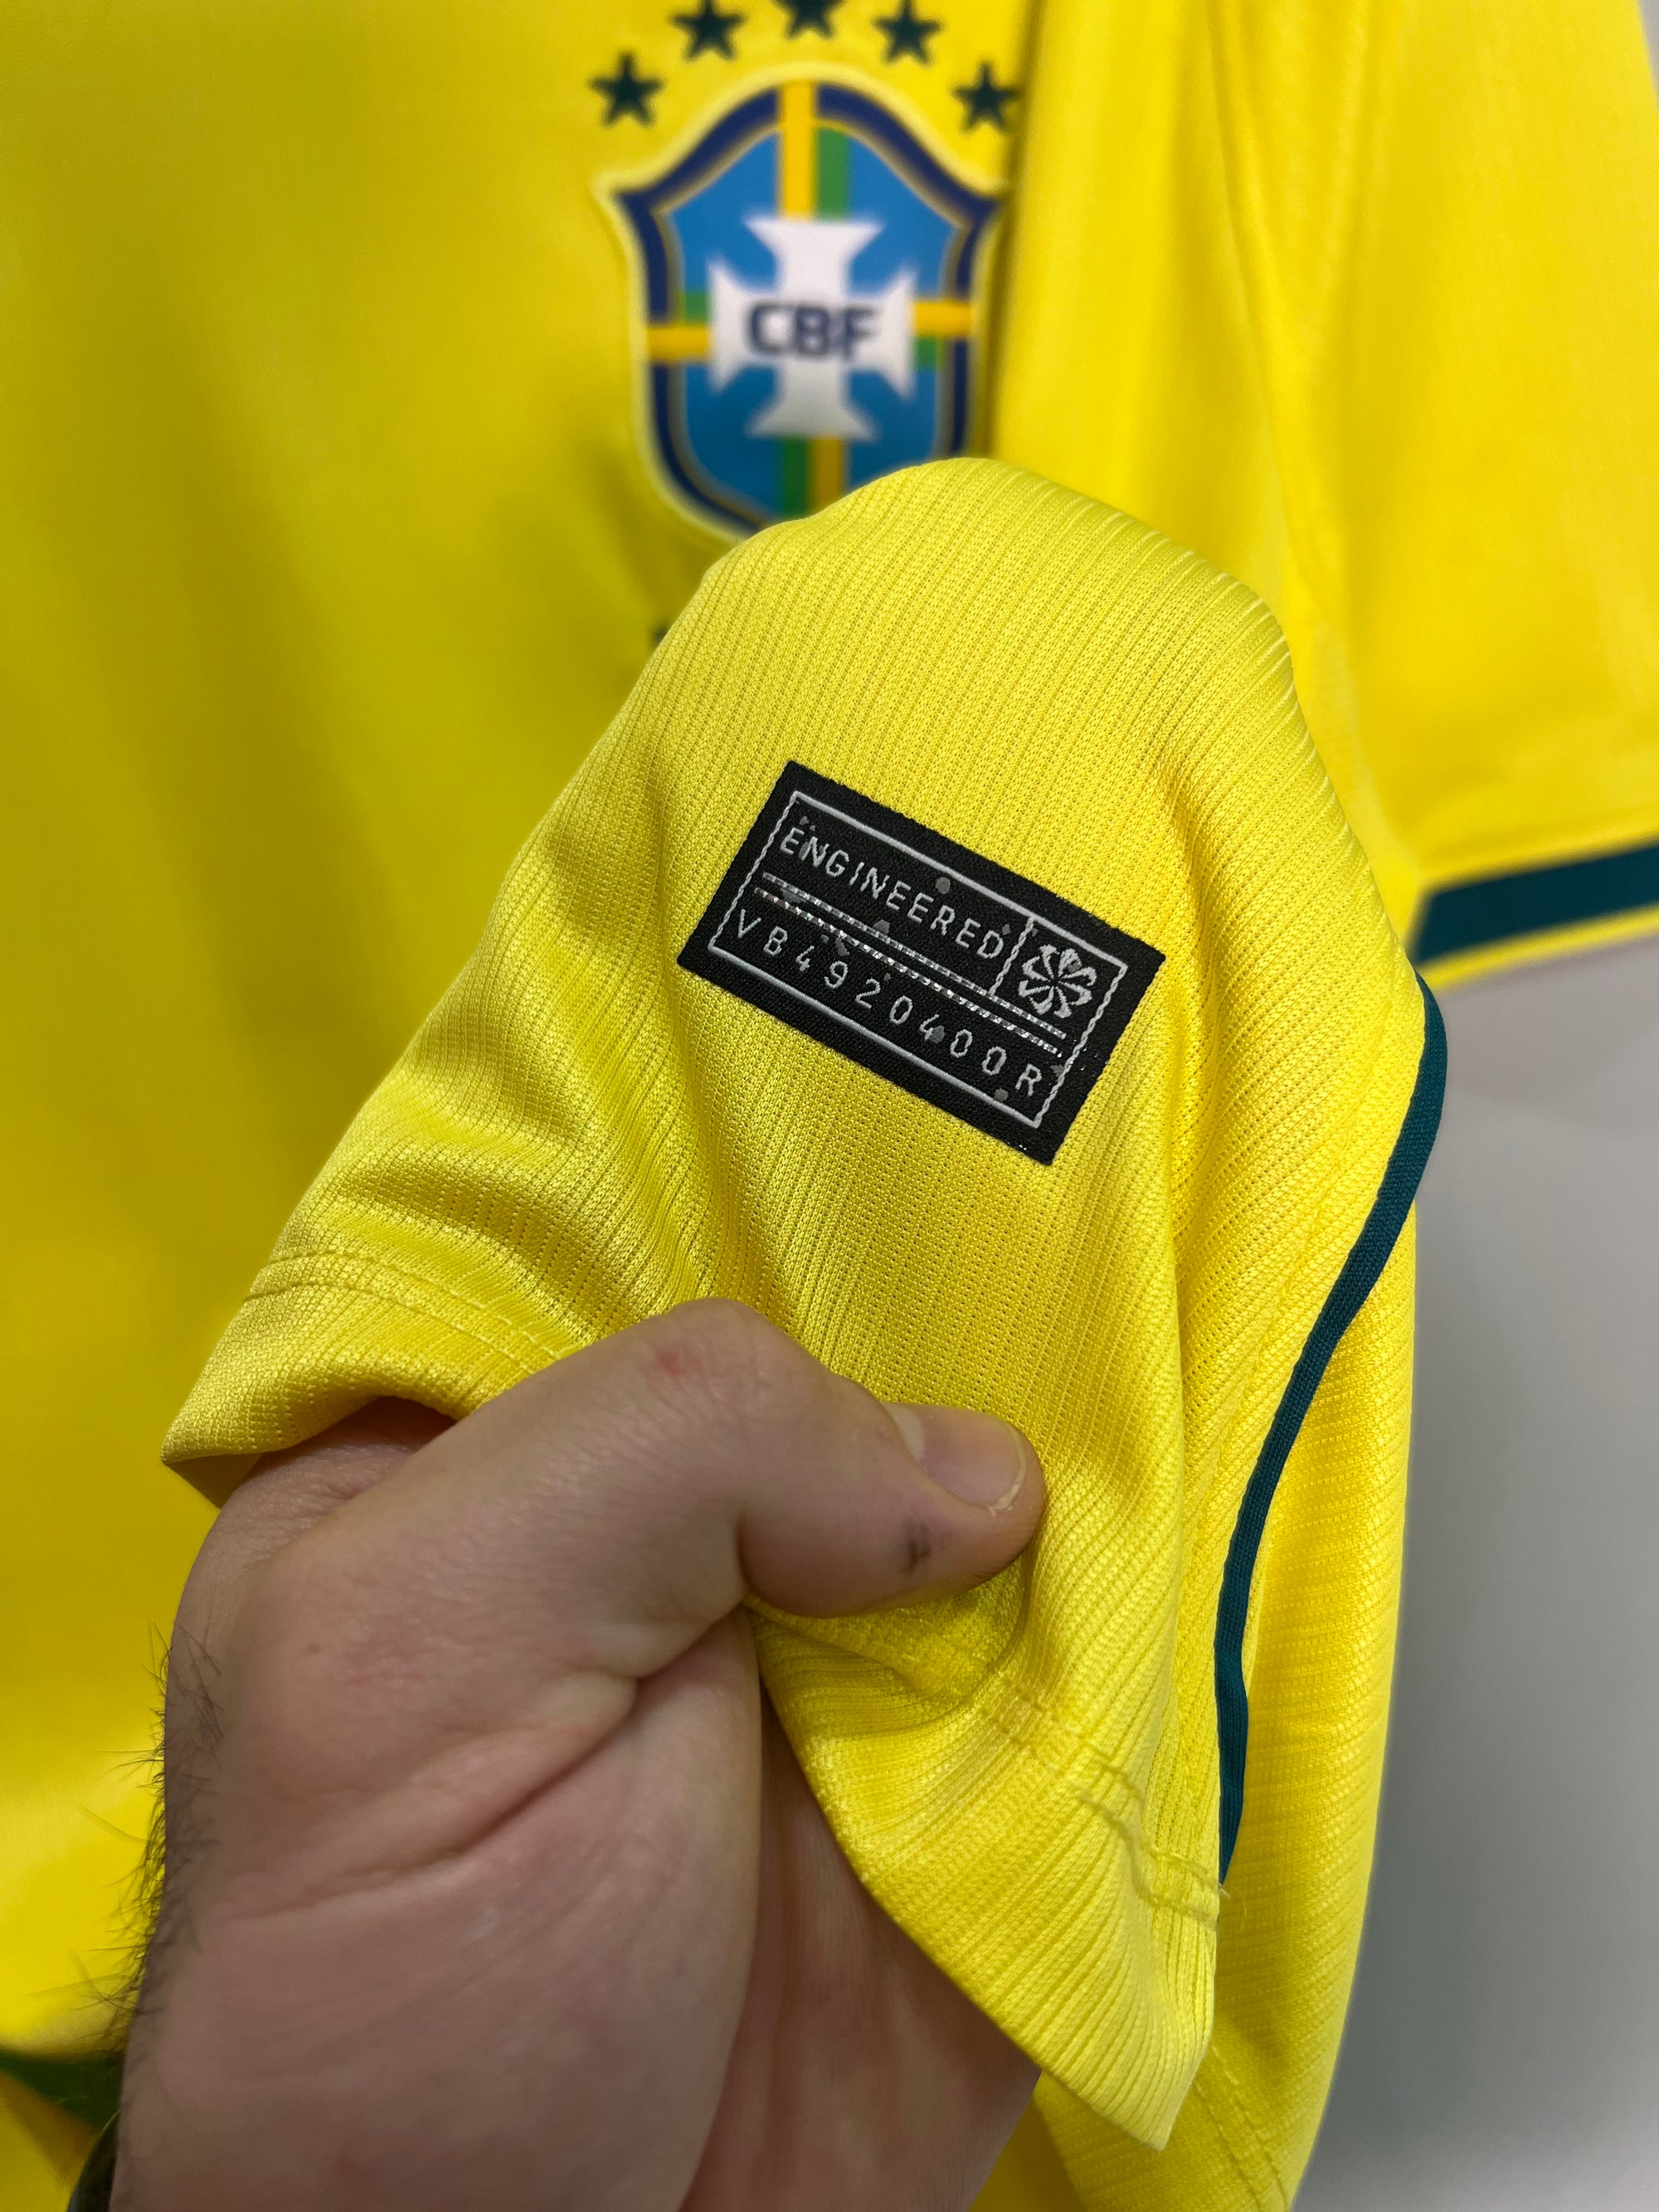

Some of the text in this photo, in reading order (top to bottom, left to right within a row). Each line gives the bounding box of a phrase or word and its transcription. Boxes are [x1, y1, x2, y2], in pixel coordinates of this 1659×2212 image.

[747, 300, 878, 359] CBF
[779, 827, 1005, 960] ENGINEERED
[736, 908, 1043, 1096] VB4920400R
